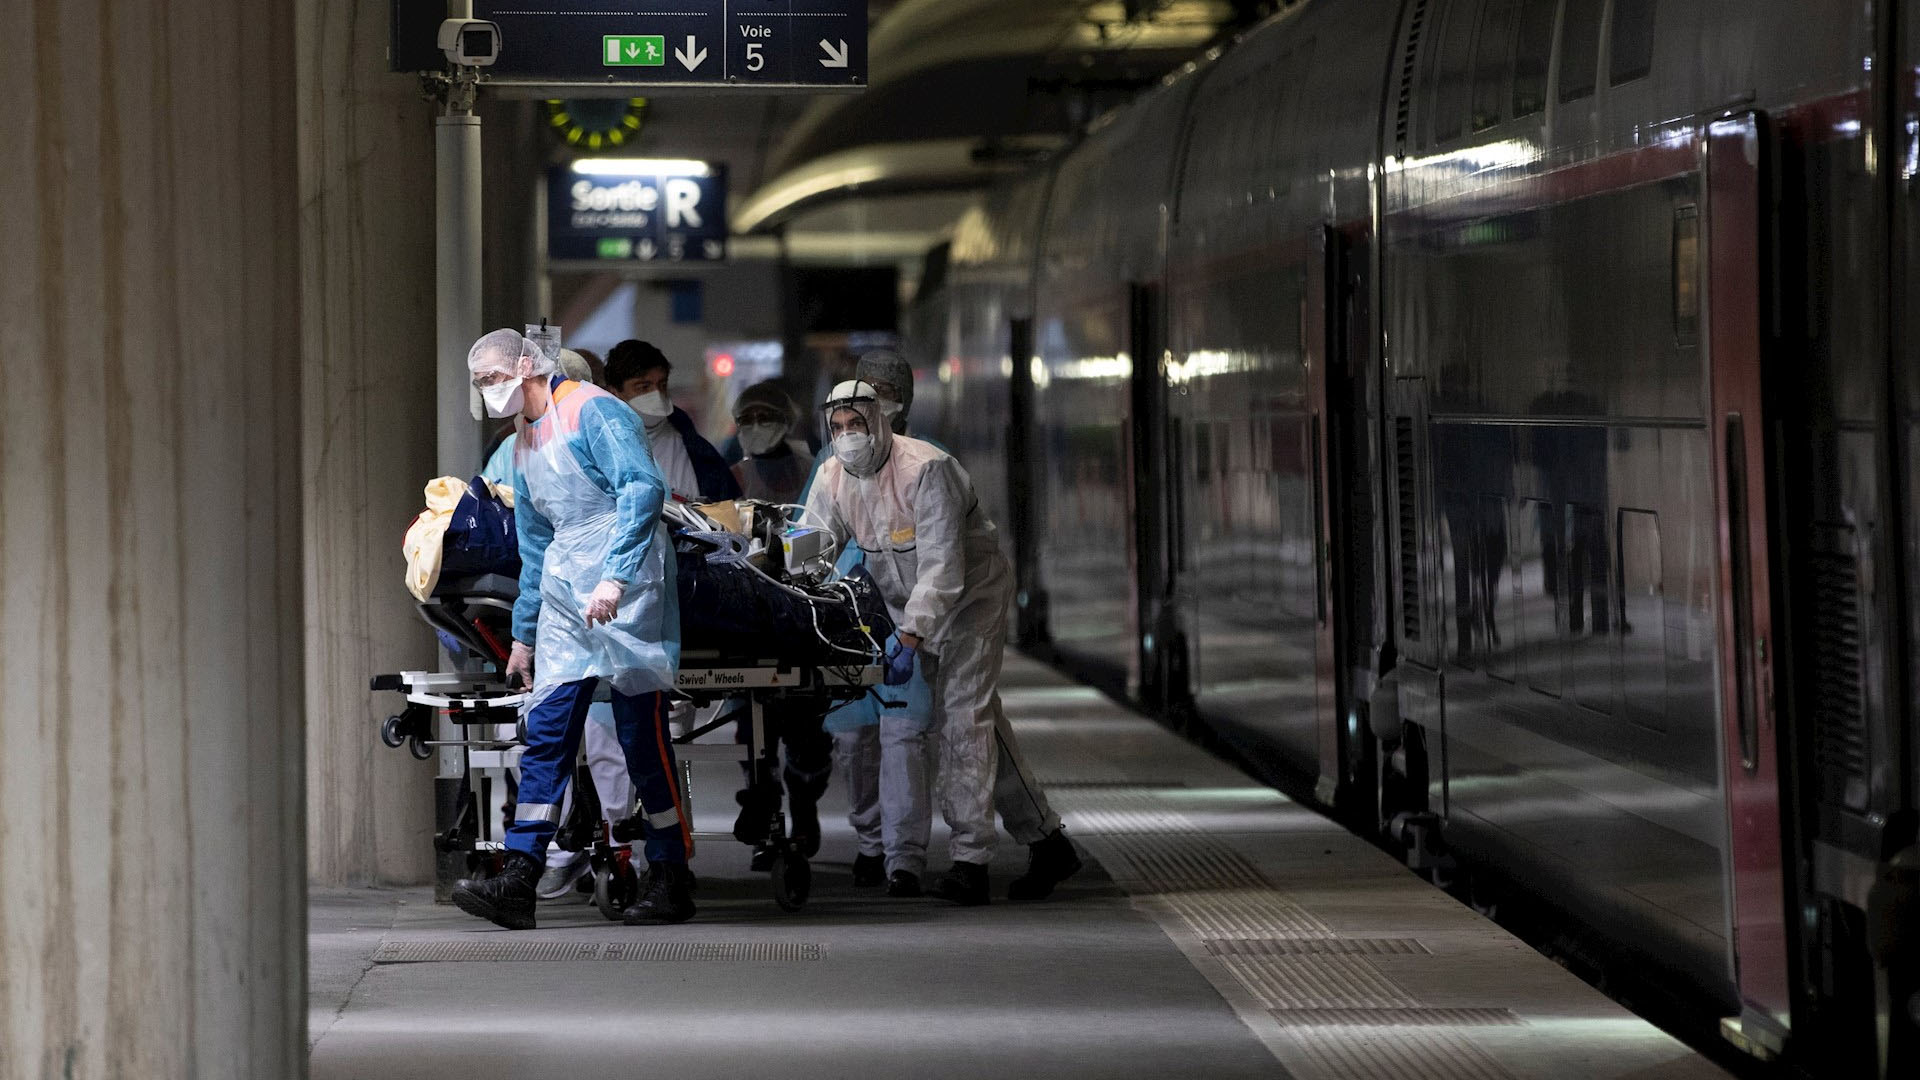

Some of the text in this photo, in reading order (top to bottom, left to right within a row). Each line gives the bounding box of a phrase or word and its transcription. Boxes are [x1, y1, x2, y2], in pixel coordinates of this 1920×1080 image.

[740, 25, 771, 37] Voie
[746, 43, 764, 71] 5
[666, 179, 702, 228] R
[714, 672, 744, 684] Wheels
